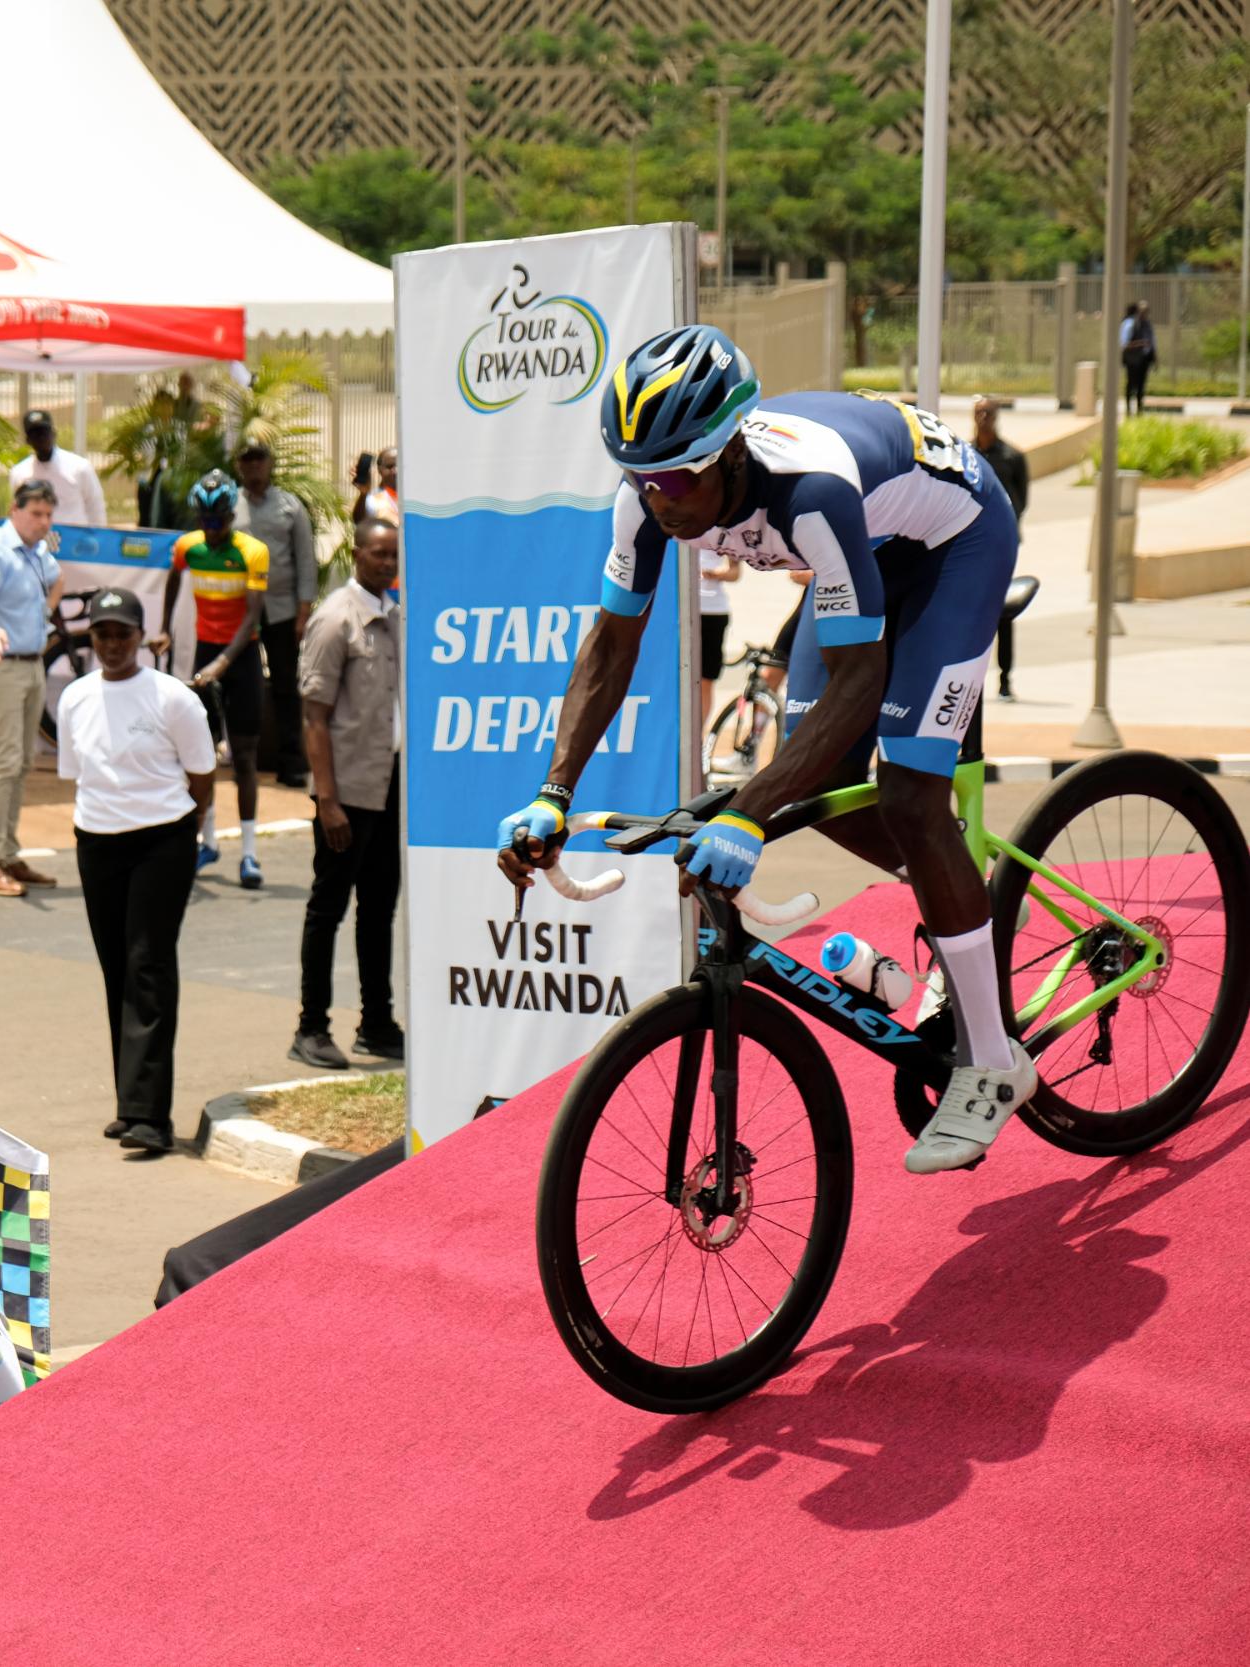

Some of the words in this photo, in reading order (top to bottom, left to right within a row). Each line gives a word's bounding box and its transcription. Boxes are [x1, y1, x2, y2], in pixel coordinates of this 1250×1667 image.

[476, 345, 587, 383] RWANDA
[816, 583, 849, 596] CMC
[816, 600, 852, 612] WCC
[431, 604, 603, 665] START
[432, 695, 651, 753] DEPAT
[935, 680, 965, 727] CMC
[487, 920, 593, 965] VISIT
[449, 966, 632, 1018] RWANDA
[749, 942, 923, 1045] RIDLEY
